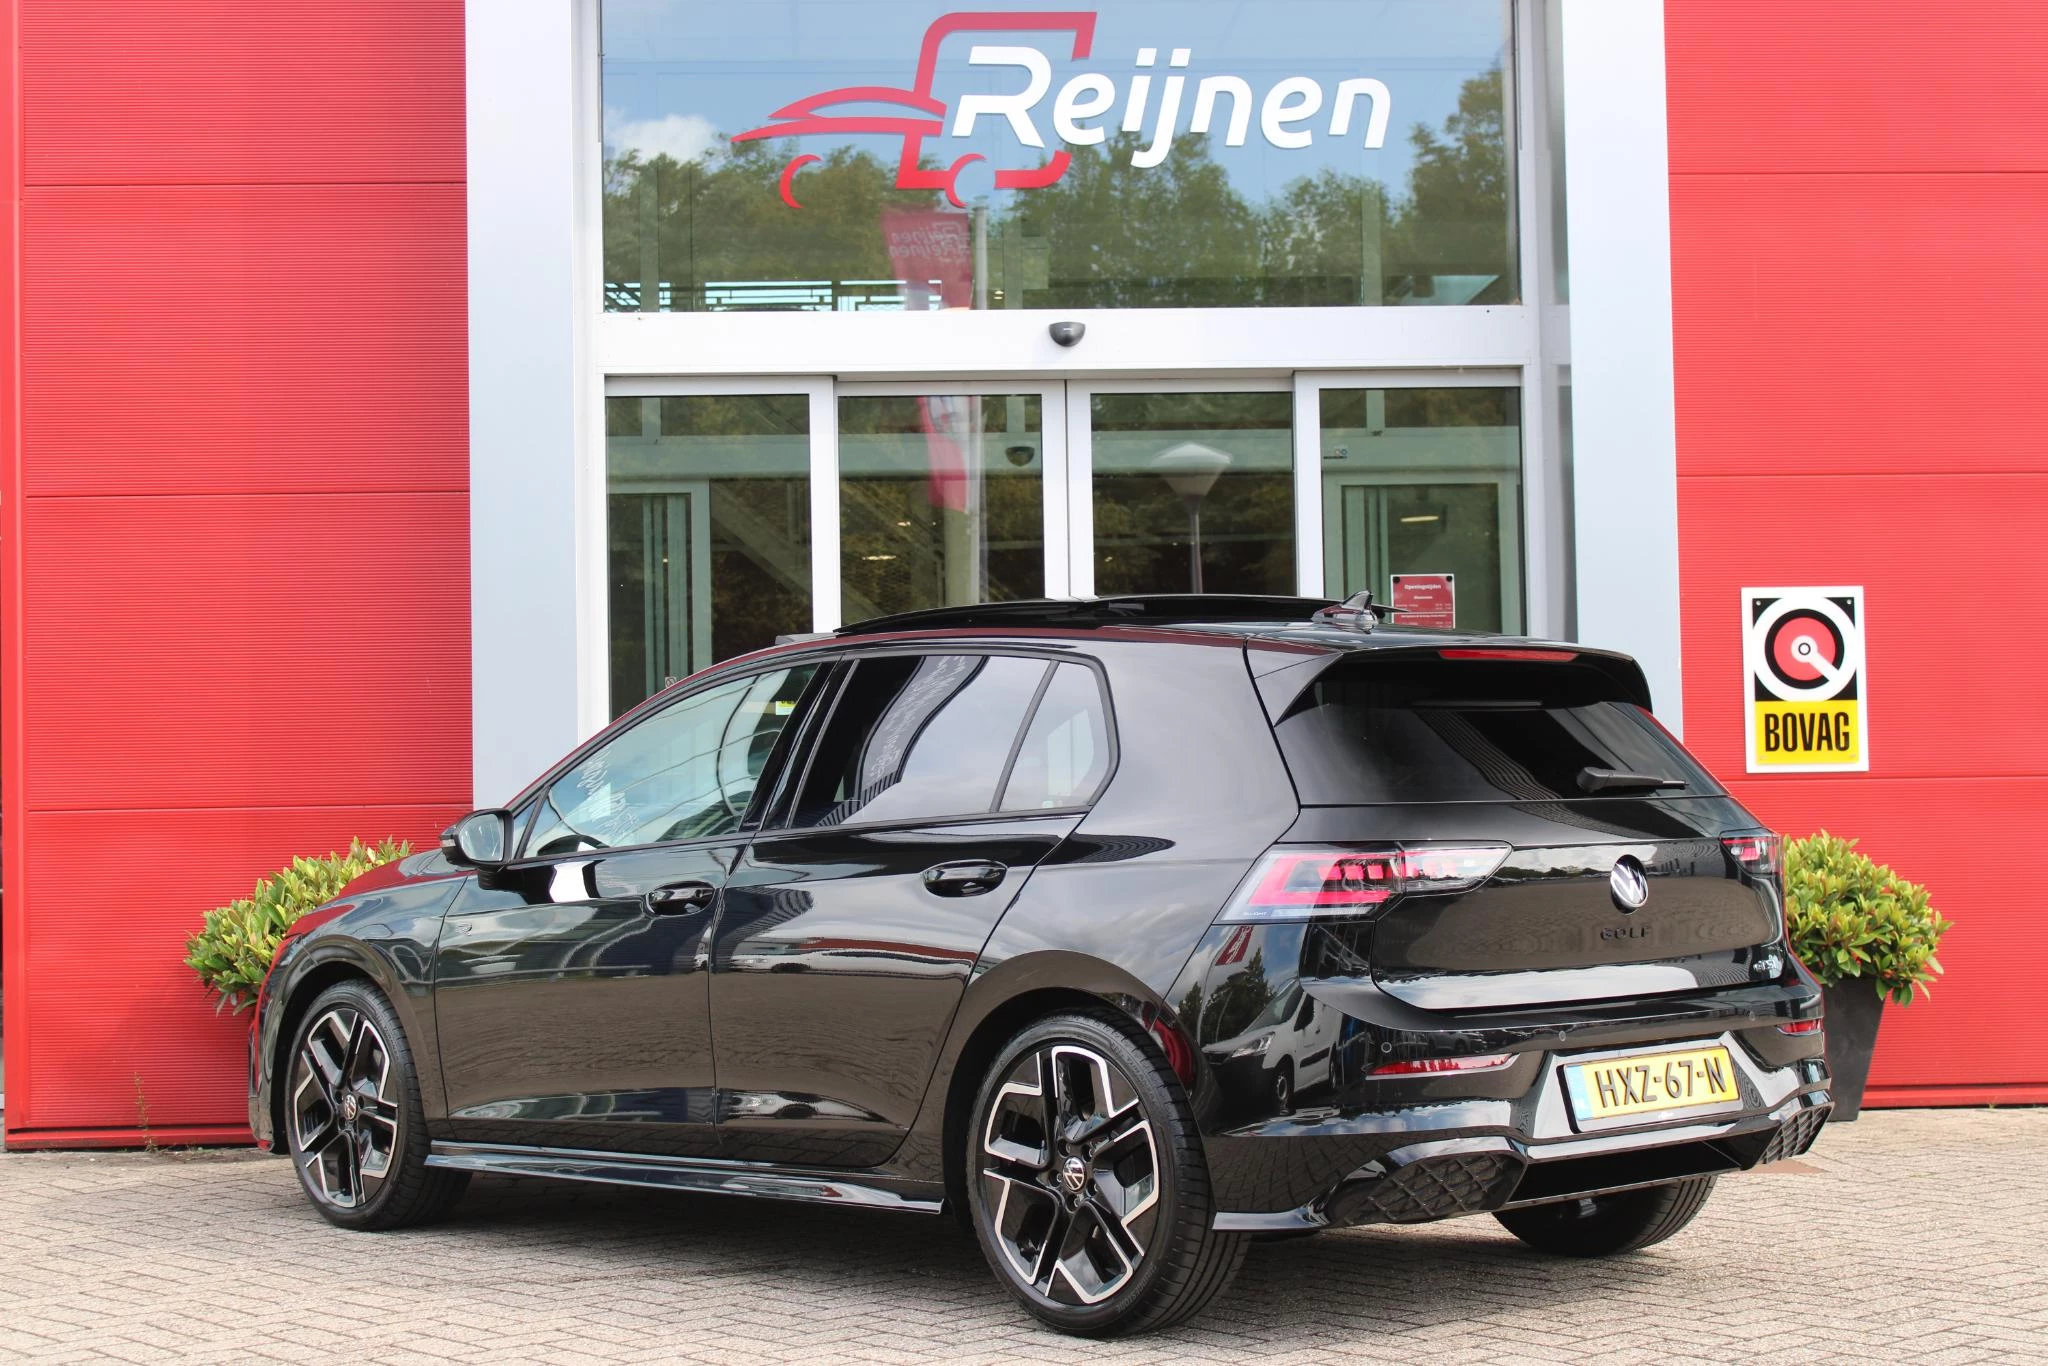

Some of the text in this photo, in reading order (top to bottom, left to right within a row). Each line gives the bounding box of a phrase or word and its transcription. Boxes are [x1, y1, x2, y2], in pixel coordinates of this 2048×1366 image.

[952, 46, 1391, 168] Reijnen
[1764, 712, 1850, 752] BOVAG
[1600, 926, 1652, 941] GOLF
[1595, 1057, 1727, 1108] HXZ-67-N
